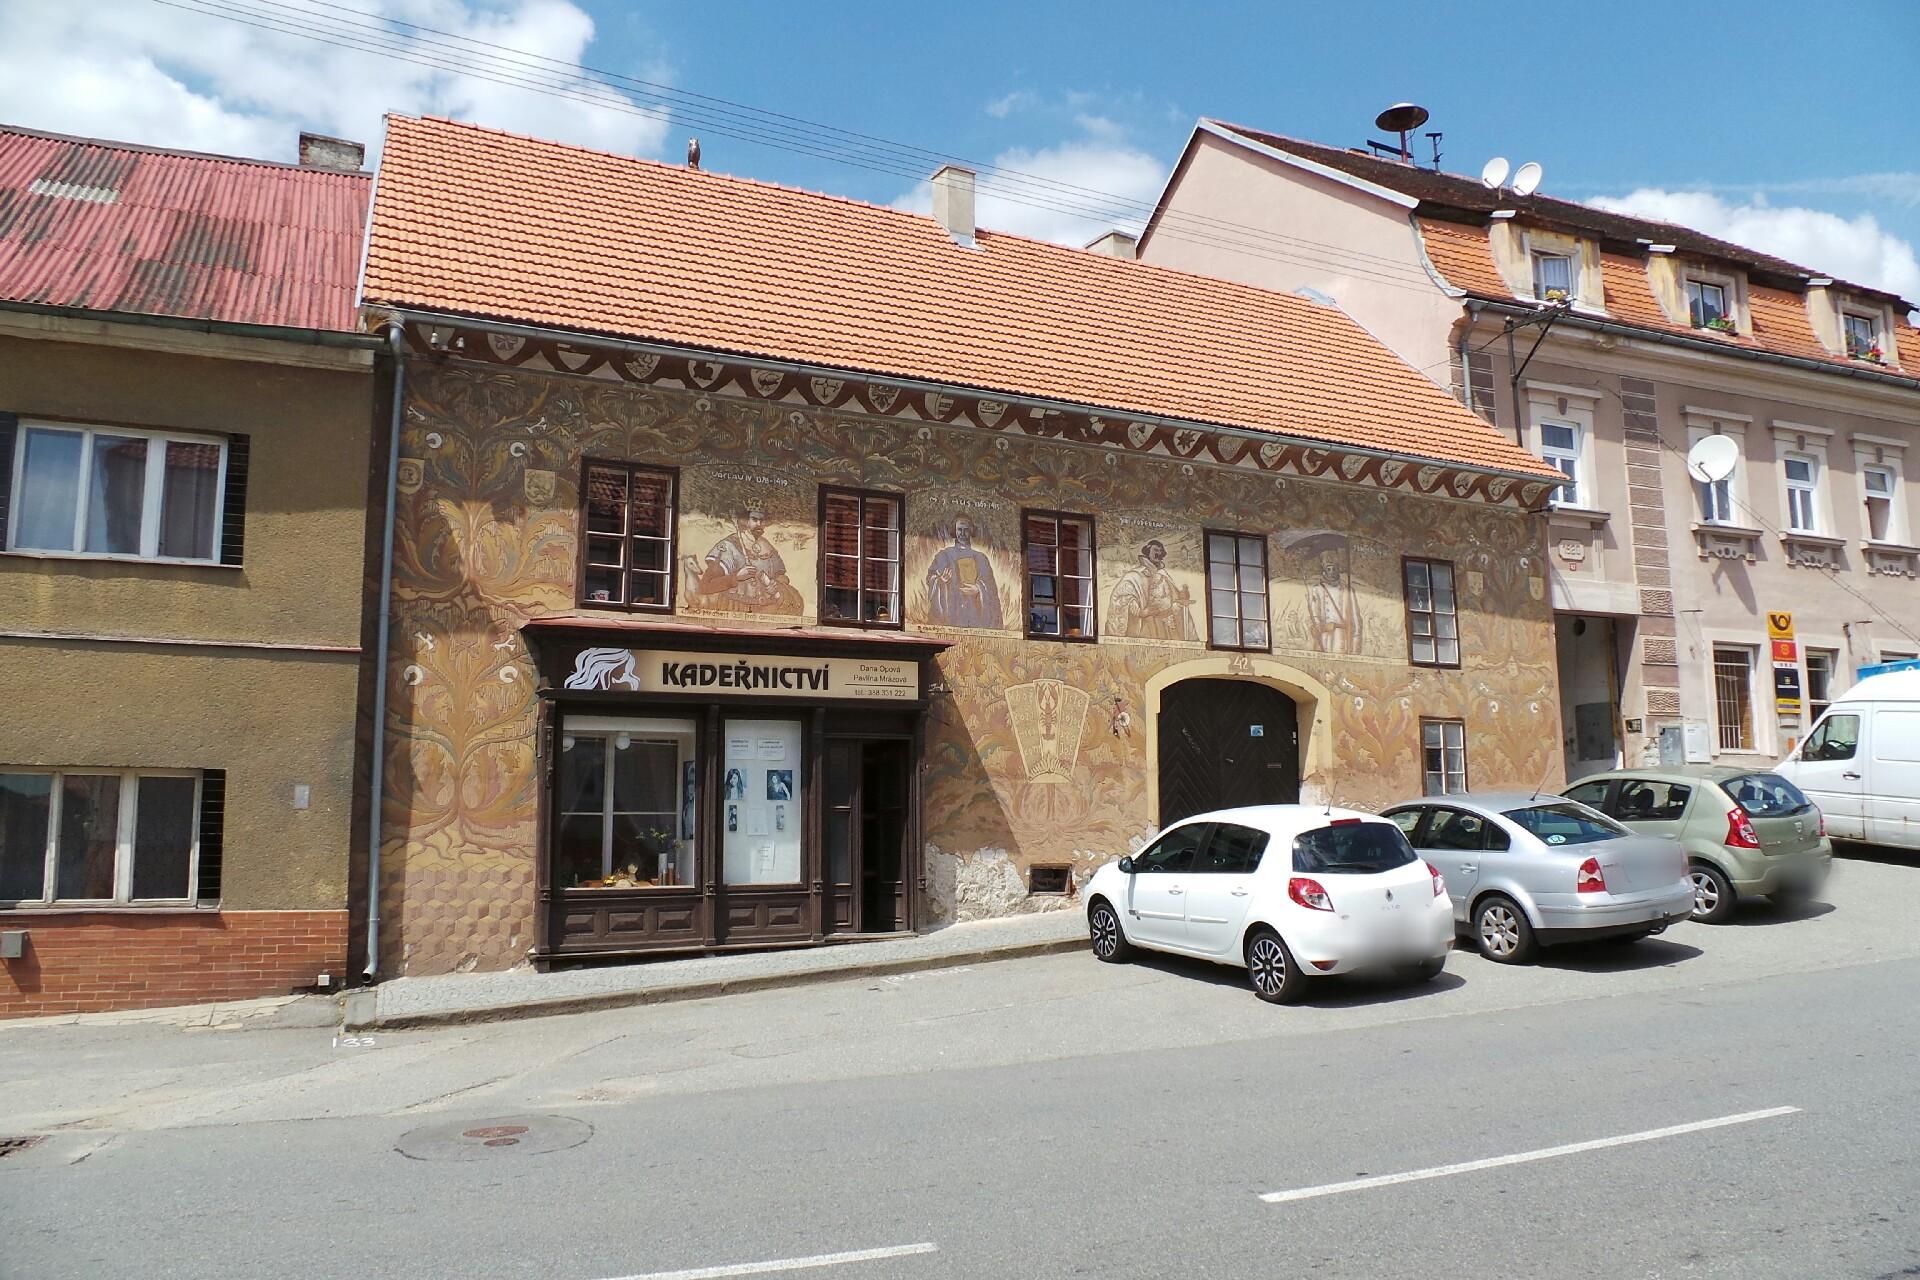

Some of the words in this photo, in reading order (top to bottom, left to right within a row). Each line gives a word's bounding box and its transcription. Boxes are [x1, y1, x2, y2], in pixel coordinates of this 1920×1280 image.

[860, 664, 878, 672] Dana
[1233, 655, 1249, 670] 42
[662, 660, 829, 691] KADEŘNICTVÍ
[332, 1037, 376, 1049] 133
